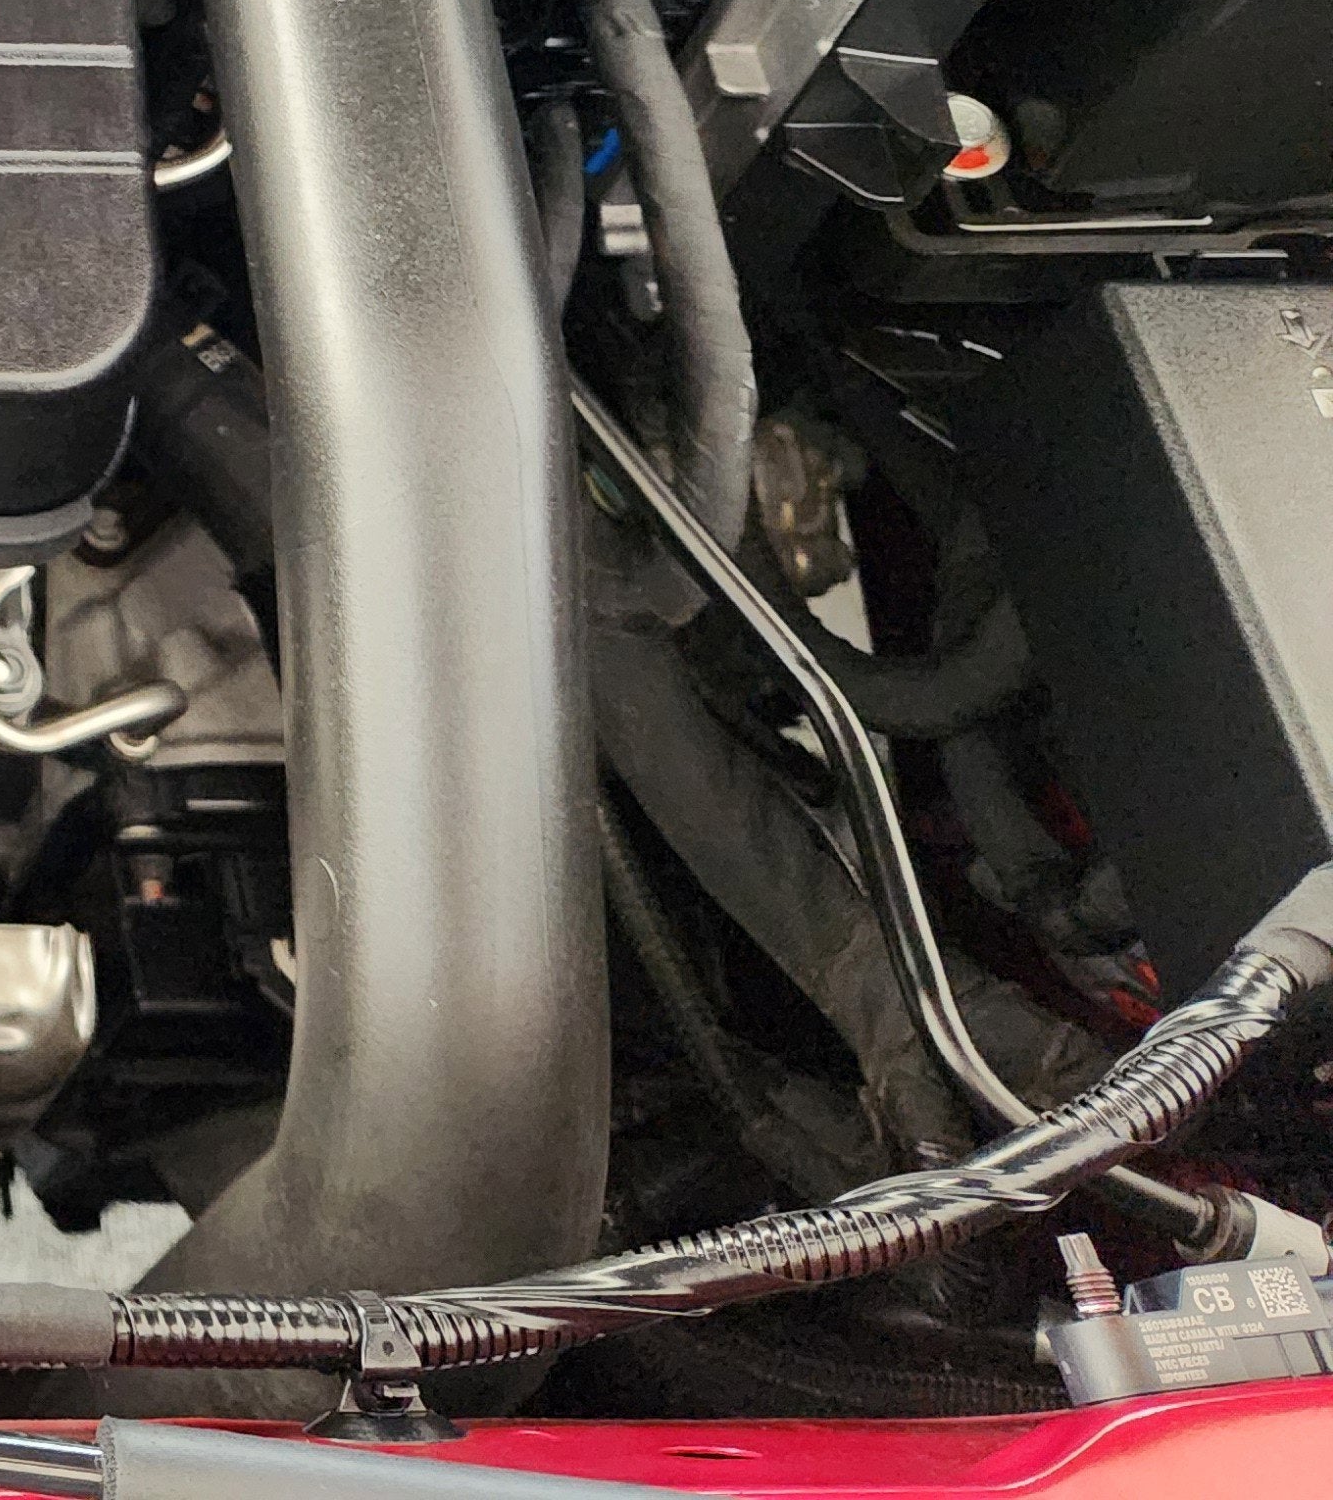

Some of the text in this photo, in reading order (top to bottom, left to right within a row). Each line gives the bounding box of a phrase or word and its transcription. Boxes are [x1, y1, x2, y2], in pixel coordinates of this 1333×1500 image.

[1193, 1286, 1235, 1314] CB
[1179, 1329, 1216, 1341] CANADA
[1216, 1325, 1239, 1337] WITH
[1154, 1358, 1179, 1371] AVEC
